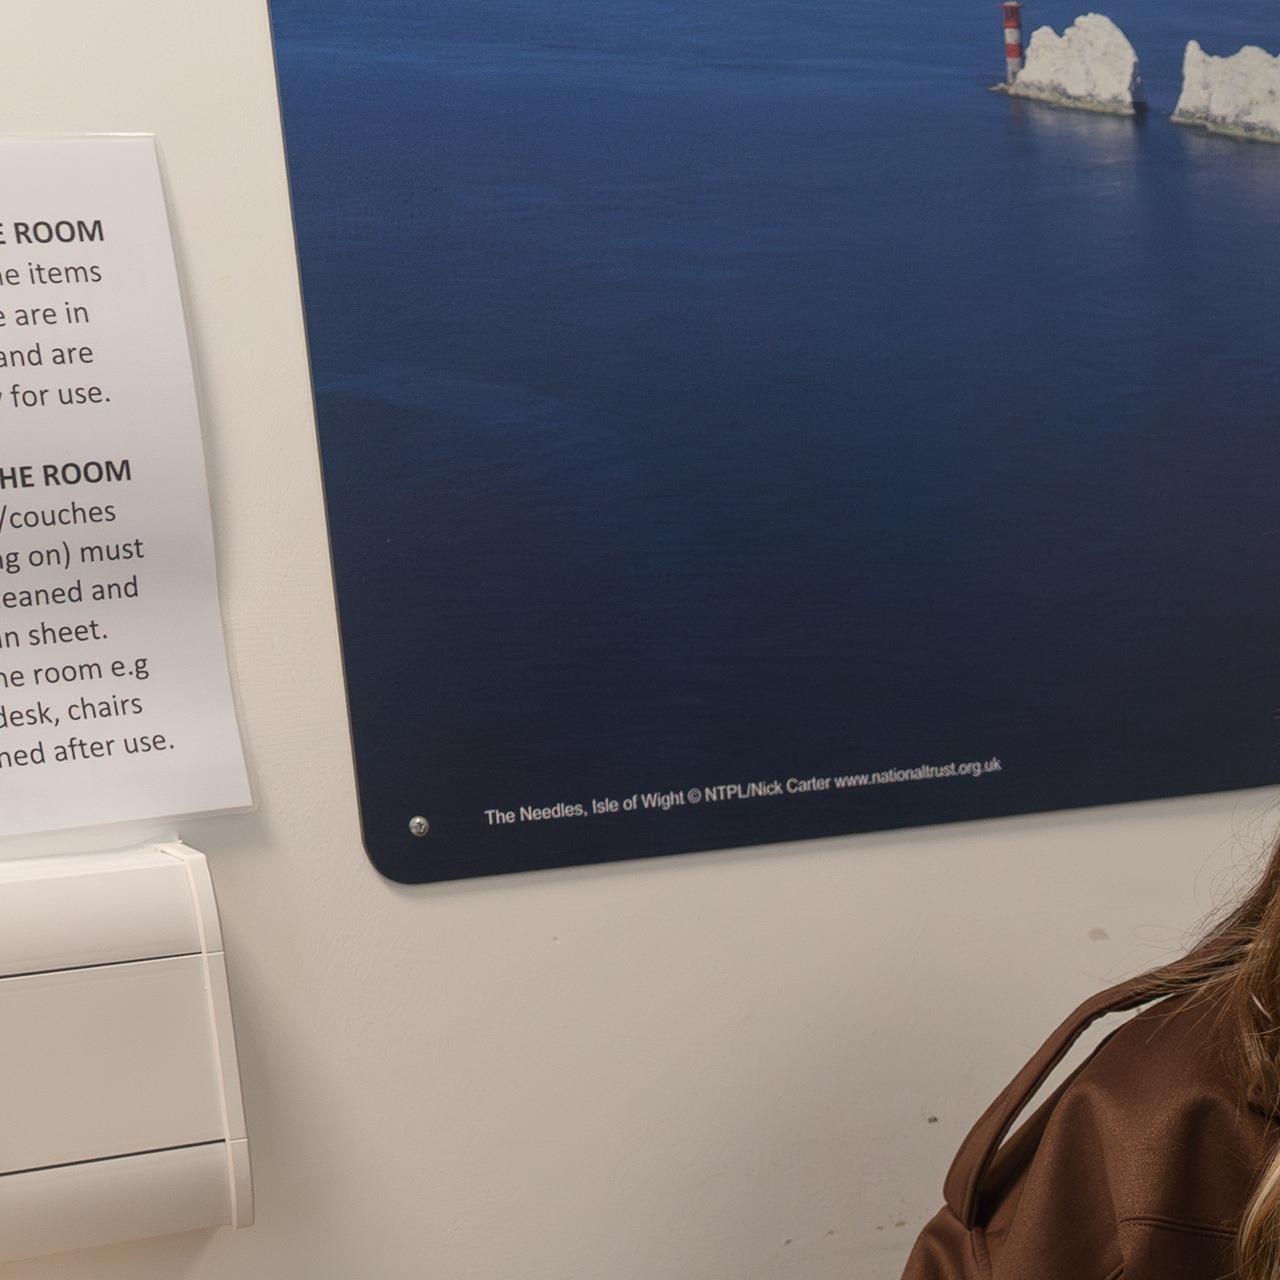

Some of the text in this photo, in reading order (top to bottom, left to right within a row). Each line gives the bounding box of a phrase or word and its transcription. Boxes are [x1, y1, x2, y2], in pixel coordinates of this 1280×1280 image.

[13, 219, 105, 244] ROOM
[28, 262, 102, 285] items
[15, 307, 57, 326] are
[65, 301, 89, 324] in
[51, 346, 94, 365] are
[10, 384, 49, 407] for
[58, 386, 111, 405] use.
[42, 459, 132, 486] ROOM
[0, 501, 116, 533] /couches
[28, 541, 70, 570] on)
[80, 538, 145, 563] must
[2, 574, 138, 608] eaned and
[28, 620, 108, 646] sheet.
[34, 662, 103, 685] room
[111, 658, 150, 680] e.g
[68, 694, 143, 721] chairs
[54, 737, 116, 762] after
[123, 733, 175, 755] use.
[484, 809, 516, 825] The
[519, 802, 588, 822] Needles,
[592, 797, 620, 815] Isle
[622, 794, 639, 812] of
[640, 790, 686, 811] Wight
[704, 780, 784, 802] NTPL/Nick
[786, 775, 831, 795] Carter
[833, 756, 1003, 788] www.nationaltrust.org.uk
